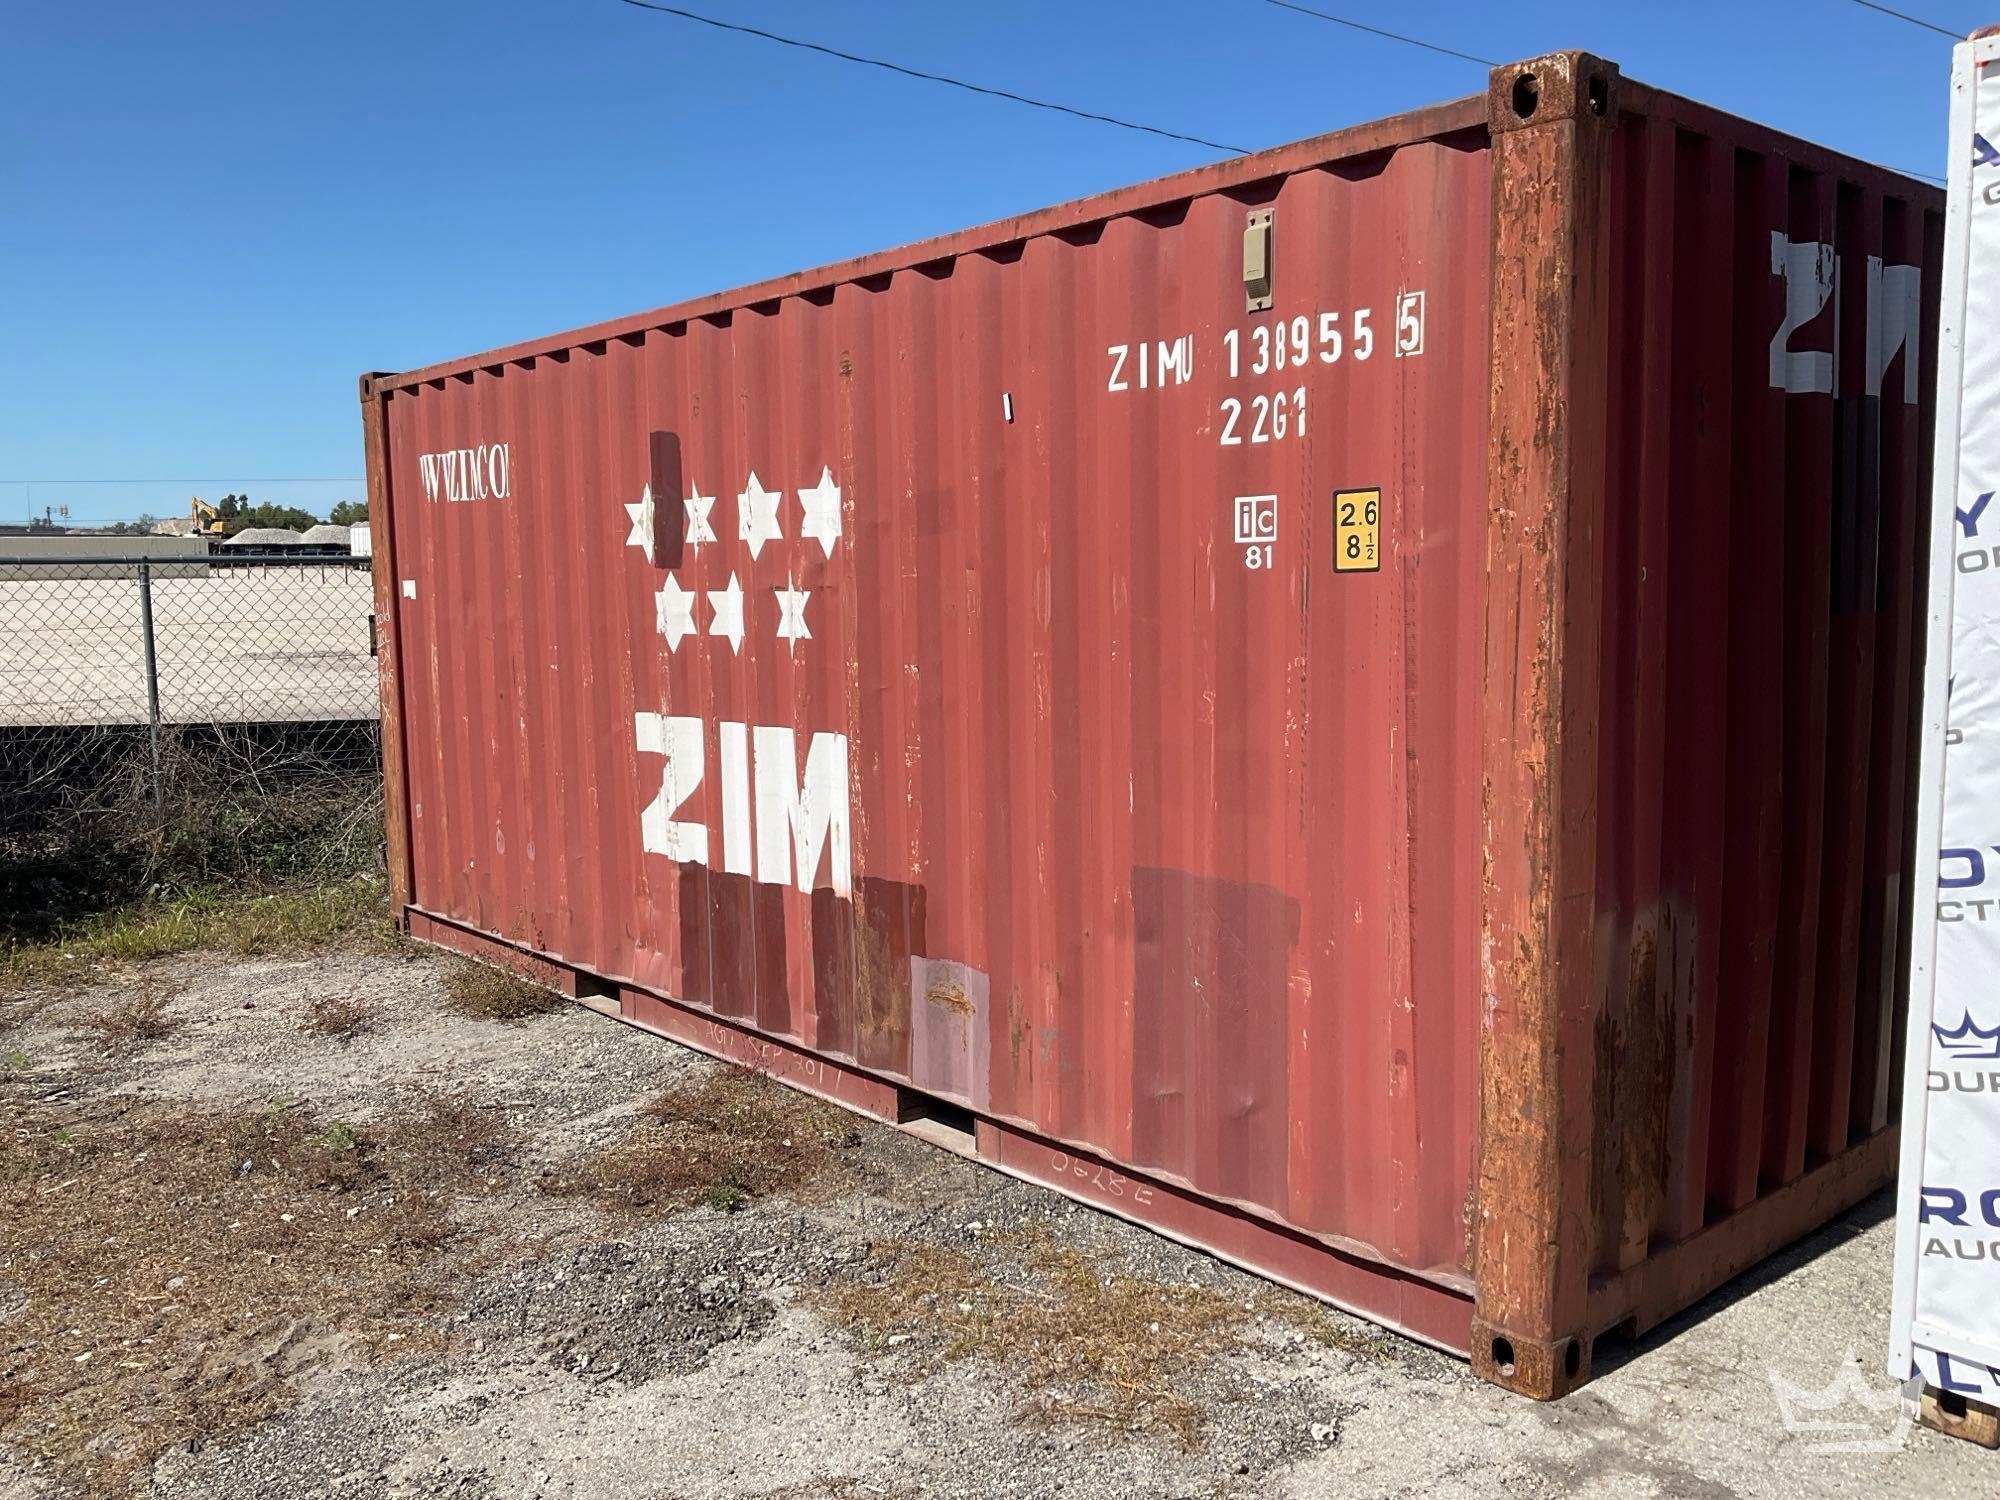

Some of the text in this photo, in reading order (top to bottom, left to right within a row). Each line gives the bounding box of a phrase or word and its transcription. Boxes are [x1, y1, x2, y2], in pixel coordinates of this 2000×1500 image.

[1107, 296, 1421, 392] ZIMU 138955 5
[1219, 386, 1307, 446] 22G1
[1340, 500, 1377, 526] 2.6
[1245, 545, 1273, 570] 81
[635, 711, 853, 904] ZIM
[1937, 898, 2000, 922] CT
